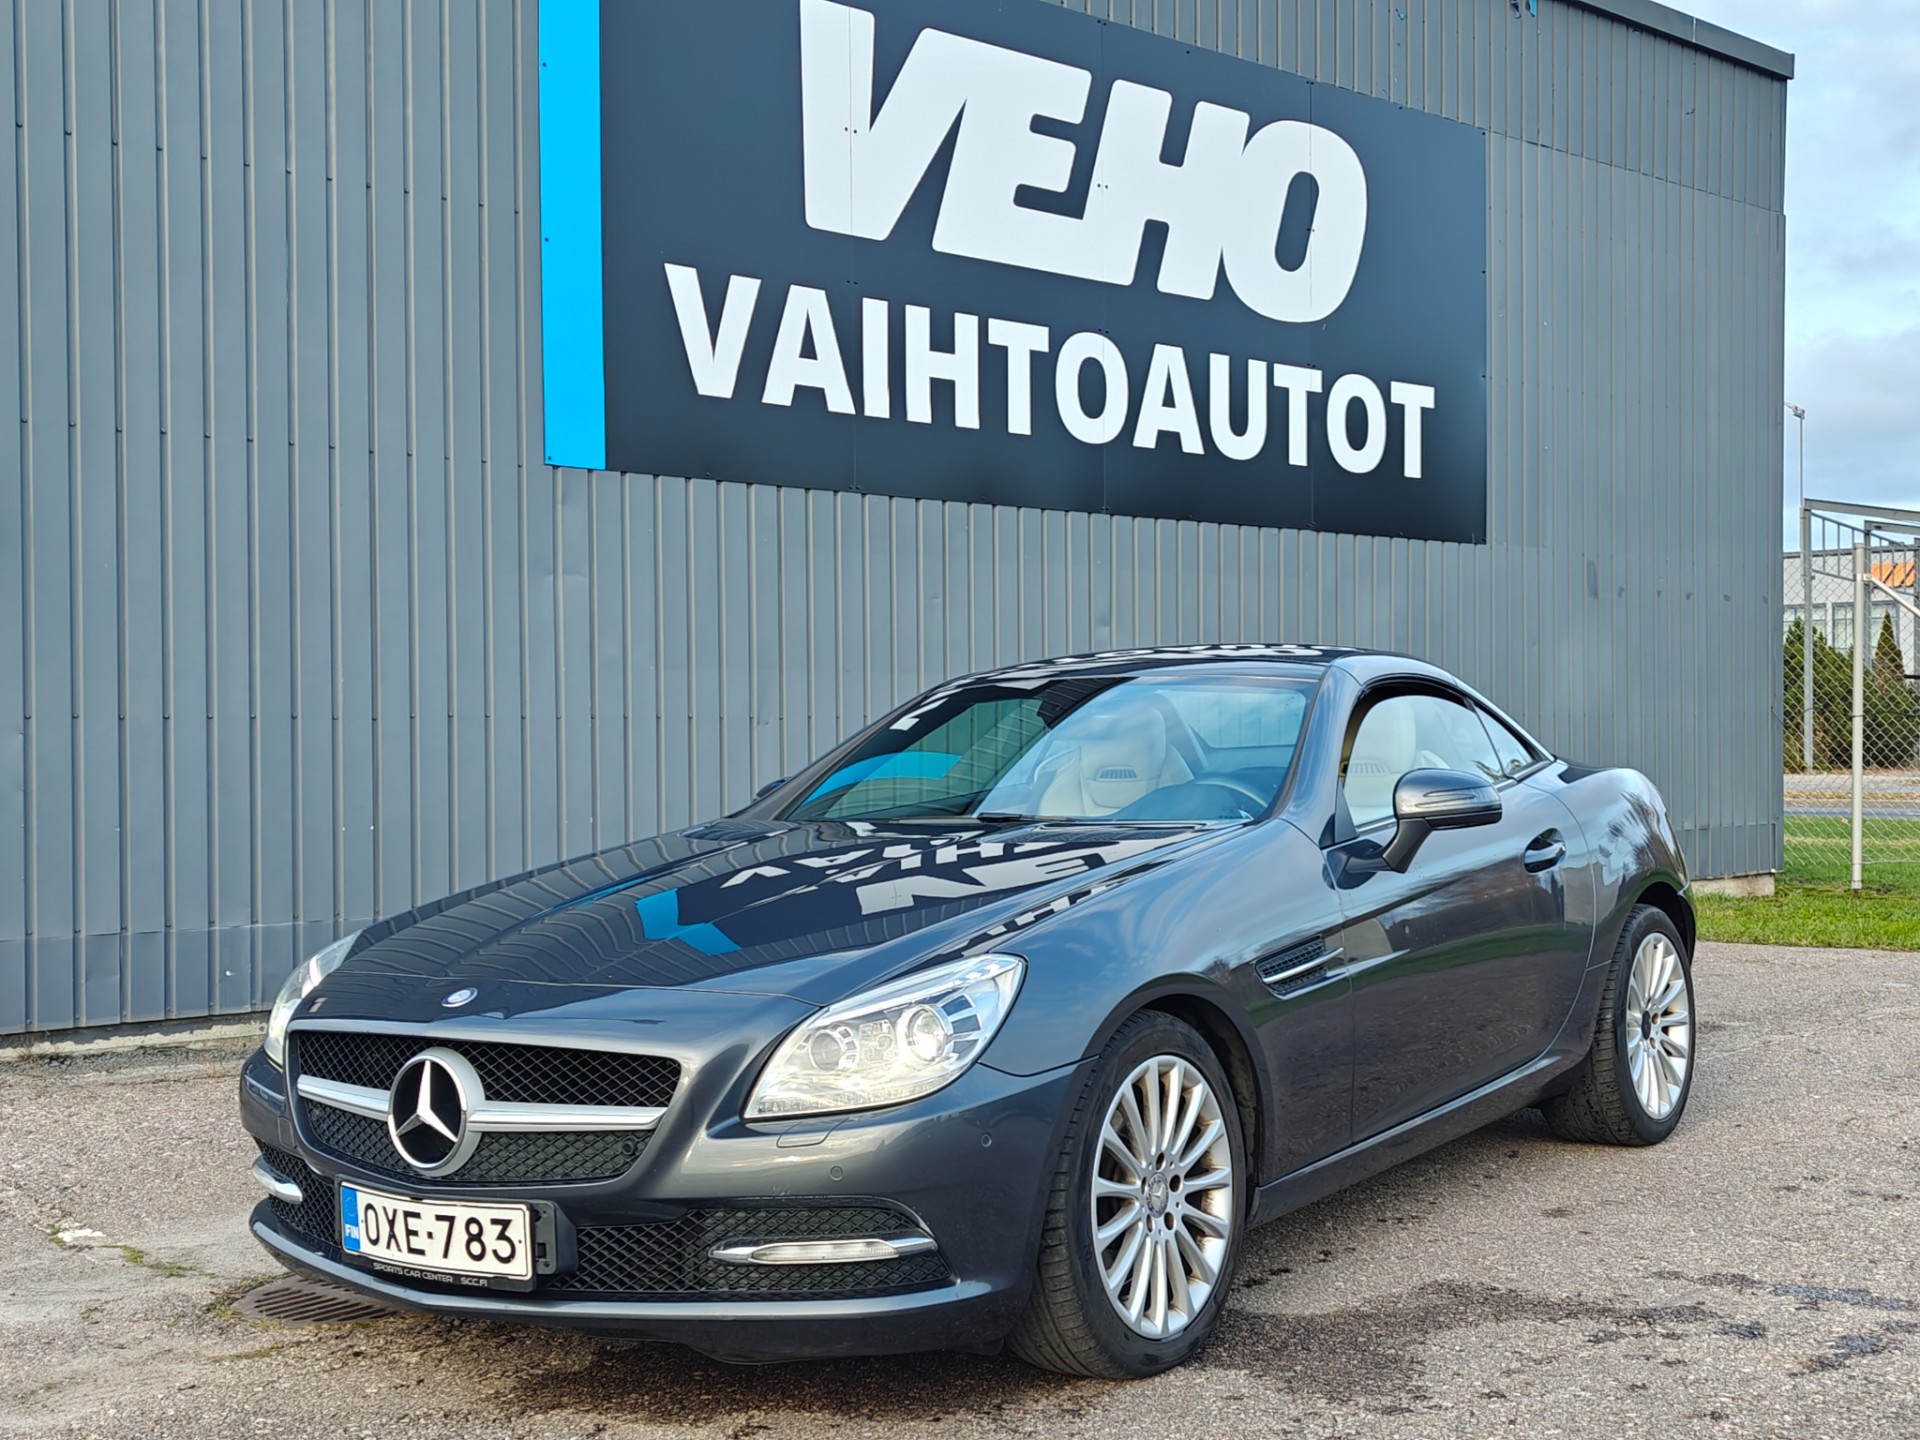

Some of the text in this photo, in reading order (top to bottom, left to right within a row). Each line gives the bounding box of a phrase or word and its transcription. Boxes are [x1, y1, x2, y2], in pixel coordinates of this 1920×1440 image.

[800, 0, 1367, 323] VEHO
[664, 263, 1435, 479] VAIHTOAUTOT
[344, 1224, 360, 1240] FIN
[363, 1202, 517, 1264] OXE-783
[372, 1262, 488, 1287] SPORTS CAR CENTER SCC.FI
